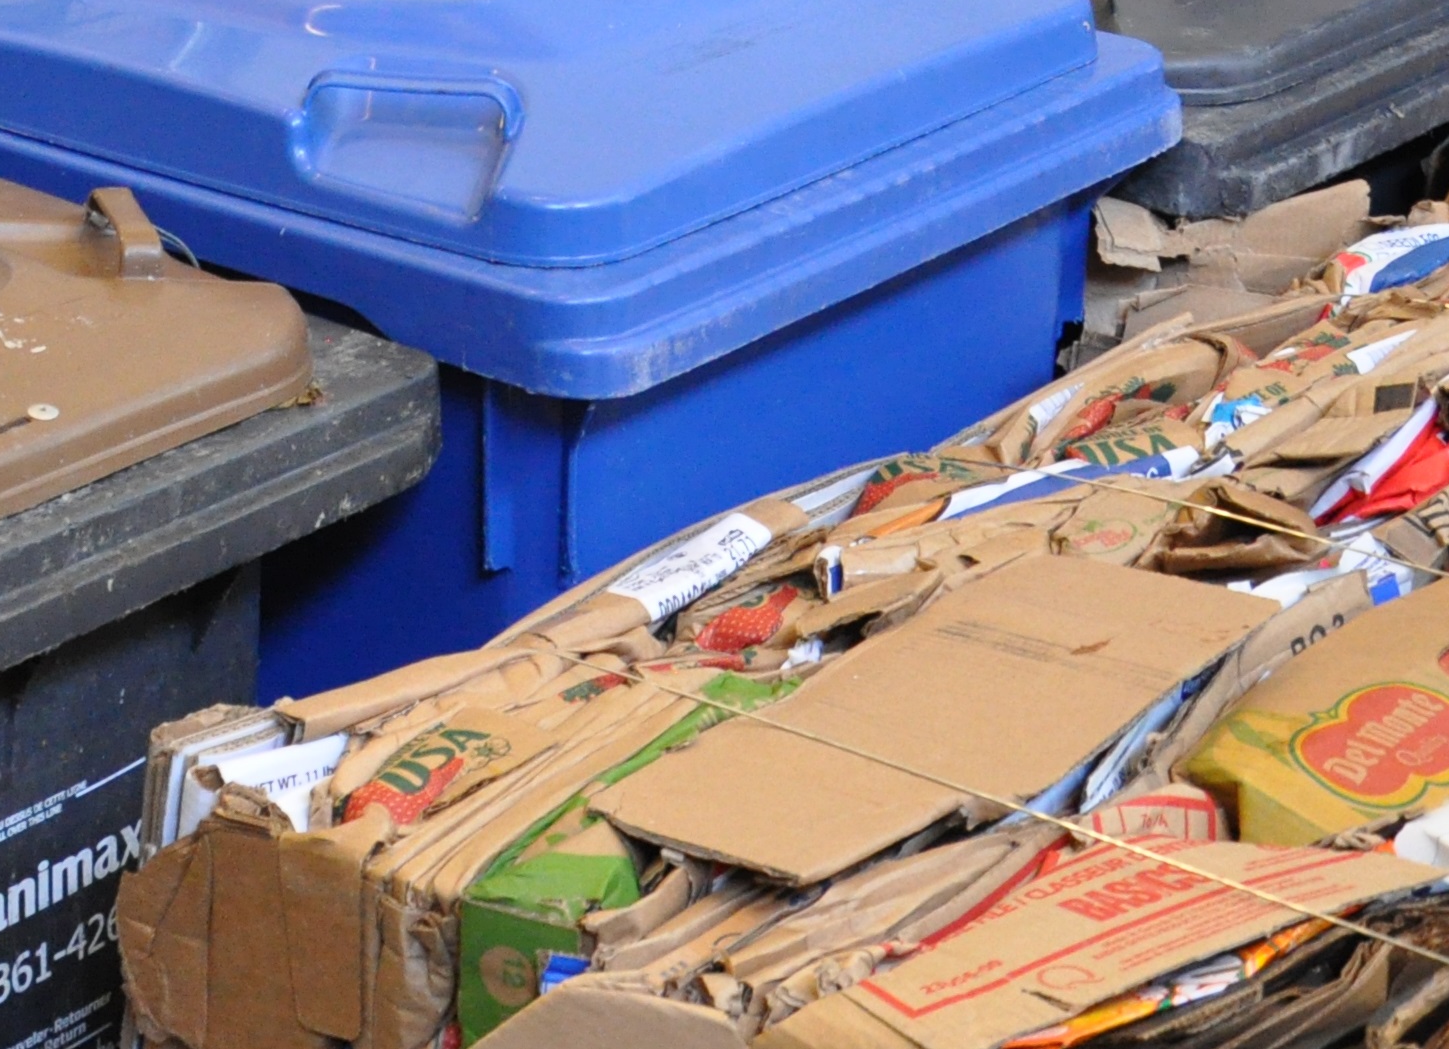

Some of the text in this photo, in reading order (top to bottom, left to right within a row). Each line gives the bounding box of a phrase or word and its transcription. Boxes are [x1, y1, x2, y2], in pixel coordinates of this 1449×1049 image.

[1322, 692, 1445, 786] Del Monte
[377, 728, 491, 794] USA
[277, 773, 302, 794] WT.
[4, 807, 33, 828] DESSUS
[7, 820, 28, 838] OVER
[28, 812, 45, 828] THIS
[1024, 856, 1126, 900] CLASSEUR
